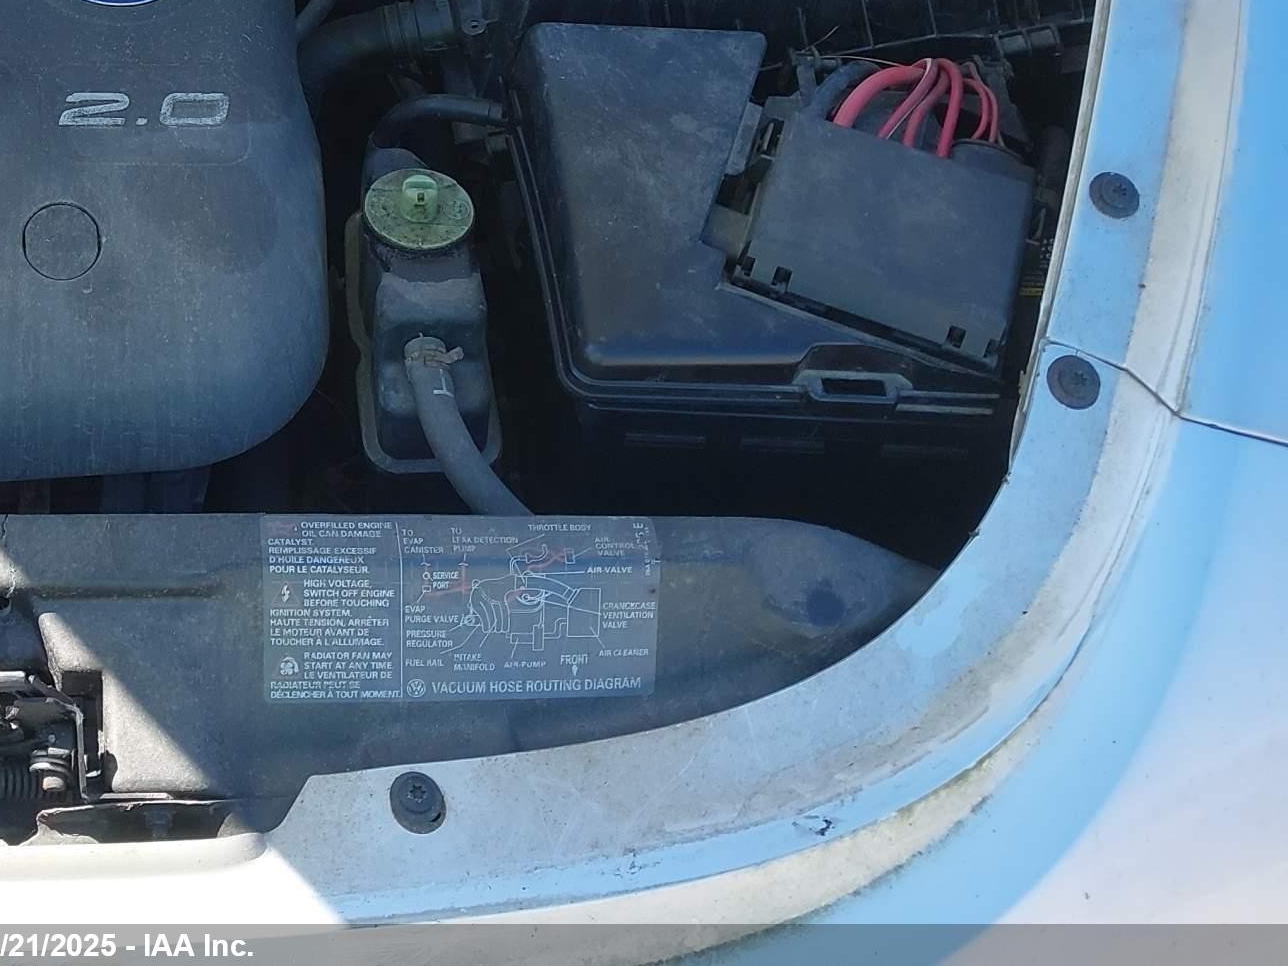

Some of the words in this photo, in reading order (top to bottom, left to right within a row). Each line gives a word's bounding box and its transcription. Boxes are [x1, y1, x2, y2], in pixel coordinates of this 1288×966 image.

[58, 92, 230, 126] 2.0
[358, 522, 392, 530] ENGINE
[306, 556, 365, 564] DANGEREUX
[270, 566, 296, 574] POUR
[296, 566, 308, 574] LE
[432, 572, 459, 580] SERVICE
[303, 580, 326, 588] HIGH
[328, 580, 372, 589] VOLTAGE,
[432, 582, 450, 590] PORT
[303, 590, 340, 598] SWITCH
[341, 590, 358, 598] OFF
[360, 590, 395, 598] ENGINE
[340, 599, 390, 607] TOUCHING
[404, 605, 426, 613] EVAP
[404, 615, 432, 623] PURGE
[433, 615, 460, 623] VALVE
[602, 612, 654, 620] VENTILATION
[270, 618, 302, 626] HAUTE
[348, 616, 390, 626] ARRÊTER
[270, 628, 281, 636] LE
[406, 630, 446, 638] PRESSURE
[406, 640, 453, 648] REGULATOR
[304, 652, 350, 660] RADIATOR
[352, 652, 370, 660] FAN
[372, 652, 393, 660] MAY
[598, 649, 612, 657] AIR
[613, 648, 649, 656] CLEANER
[405, 658, 424, 666] FUEL
[426, 658, 444, 666] RAIL
[560, 654, 588, 666] FRONT
[304, 662, 332, 670] START
[335, 662, 347, 670] AT
[348, 662, 368, 670] ANY
[370, 662, 392, 670] TIME
[454, 663, 496, 671] MANIFOLD
[324, 681, 347, 689] PEUT
[348, 681, 361, 689] SE
[432, 681, 486, 694] VACUUM
[490, 680, 523, 693] HOSE
[526, 680, 582, 692] ROUTING
[584, 677, 642, 690] DIAGRAM
[270, 689, 326, 698] DÉCLENCHER
[335, 690, 358, 698] TOUT
